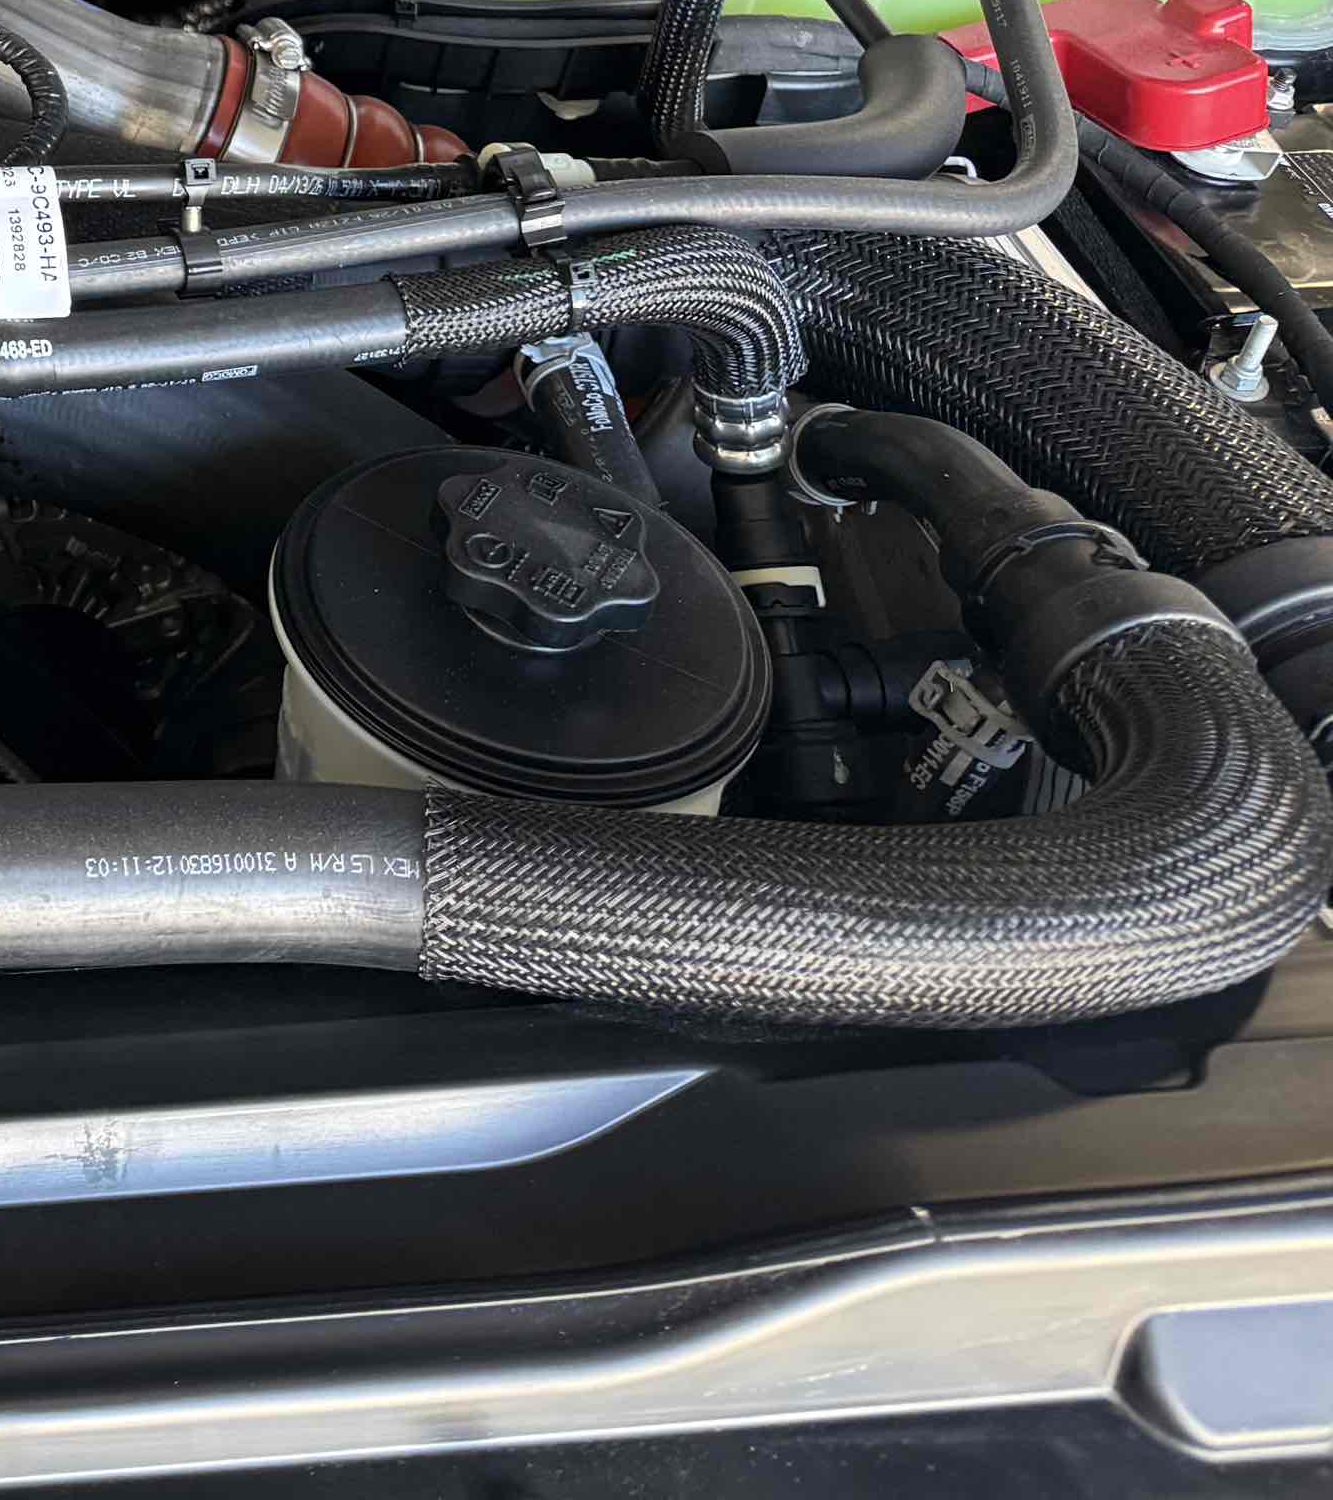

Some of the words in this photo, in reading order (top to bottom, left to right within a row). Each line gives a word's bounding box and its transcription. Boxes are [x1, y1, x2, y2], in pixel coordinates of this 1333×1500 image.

[7, 209, 26, 272] 1392828
[285, 852, 297, 873] A
[384, 856, 421, 879] MEX
